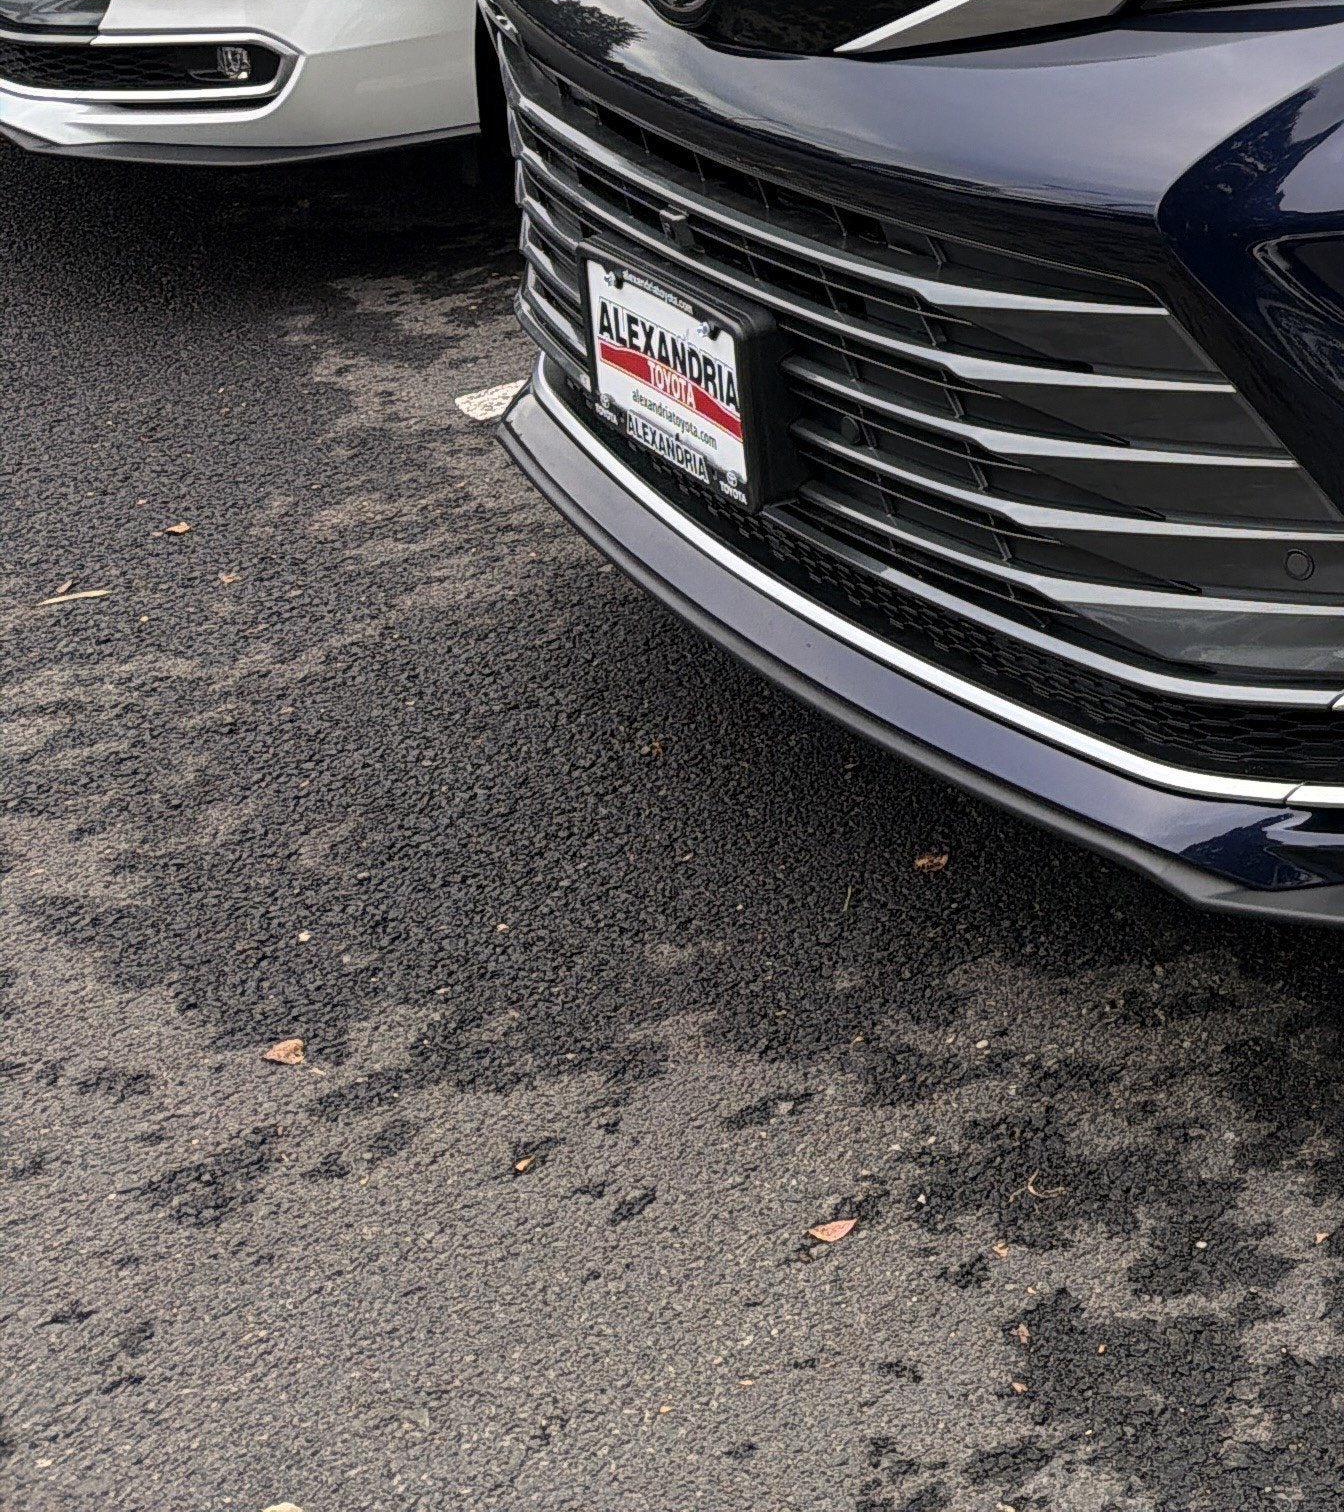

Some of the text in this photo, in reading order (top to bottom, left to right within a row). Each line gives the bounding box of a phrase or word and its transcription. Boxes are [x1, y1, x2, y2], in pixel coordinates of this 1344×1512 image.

[598, 301, 738, 410] ALEXANDRIA
[648, 359, 696, 407] TOYOTA
[627, 411, 708, 483] ALEXANDRIA
[631, 388, 717, 450] alexandriatoyota.com
[720, 481, 748, 505] TOYOTA
